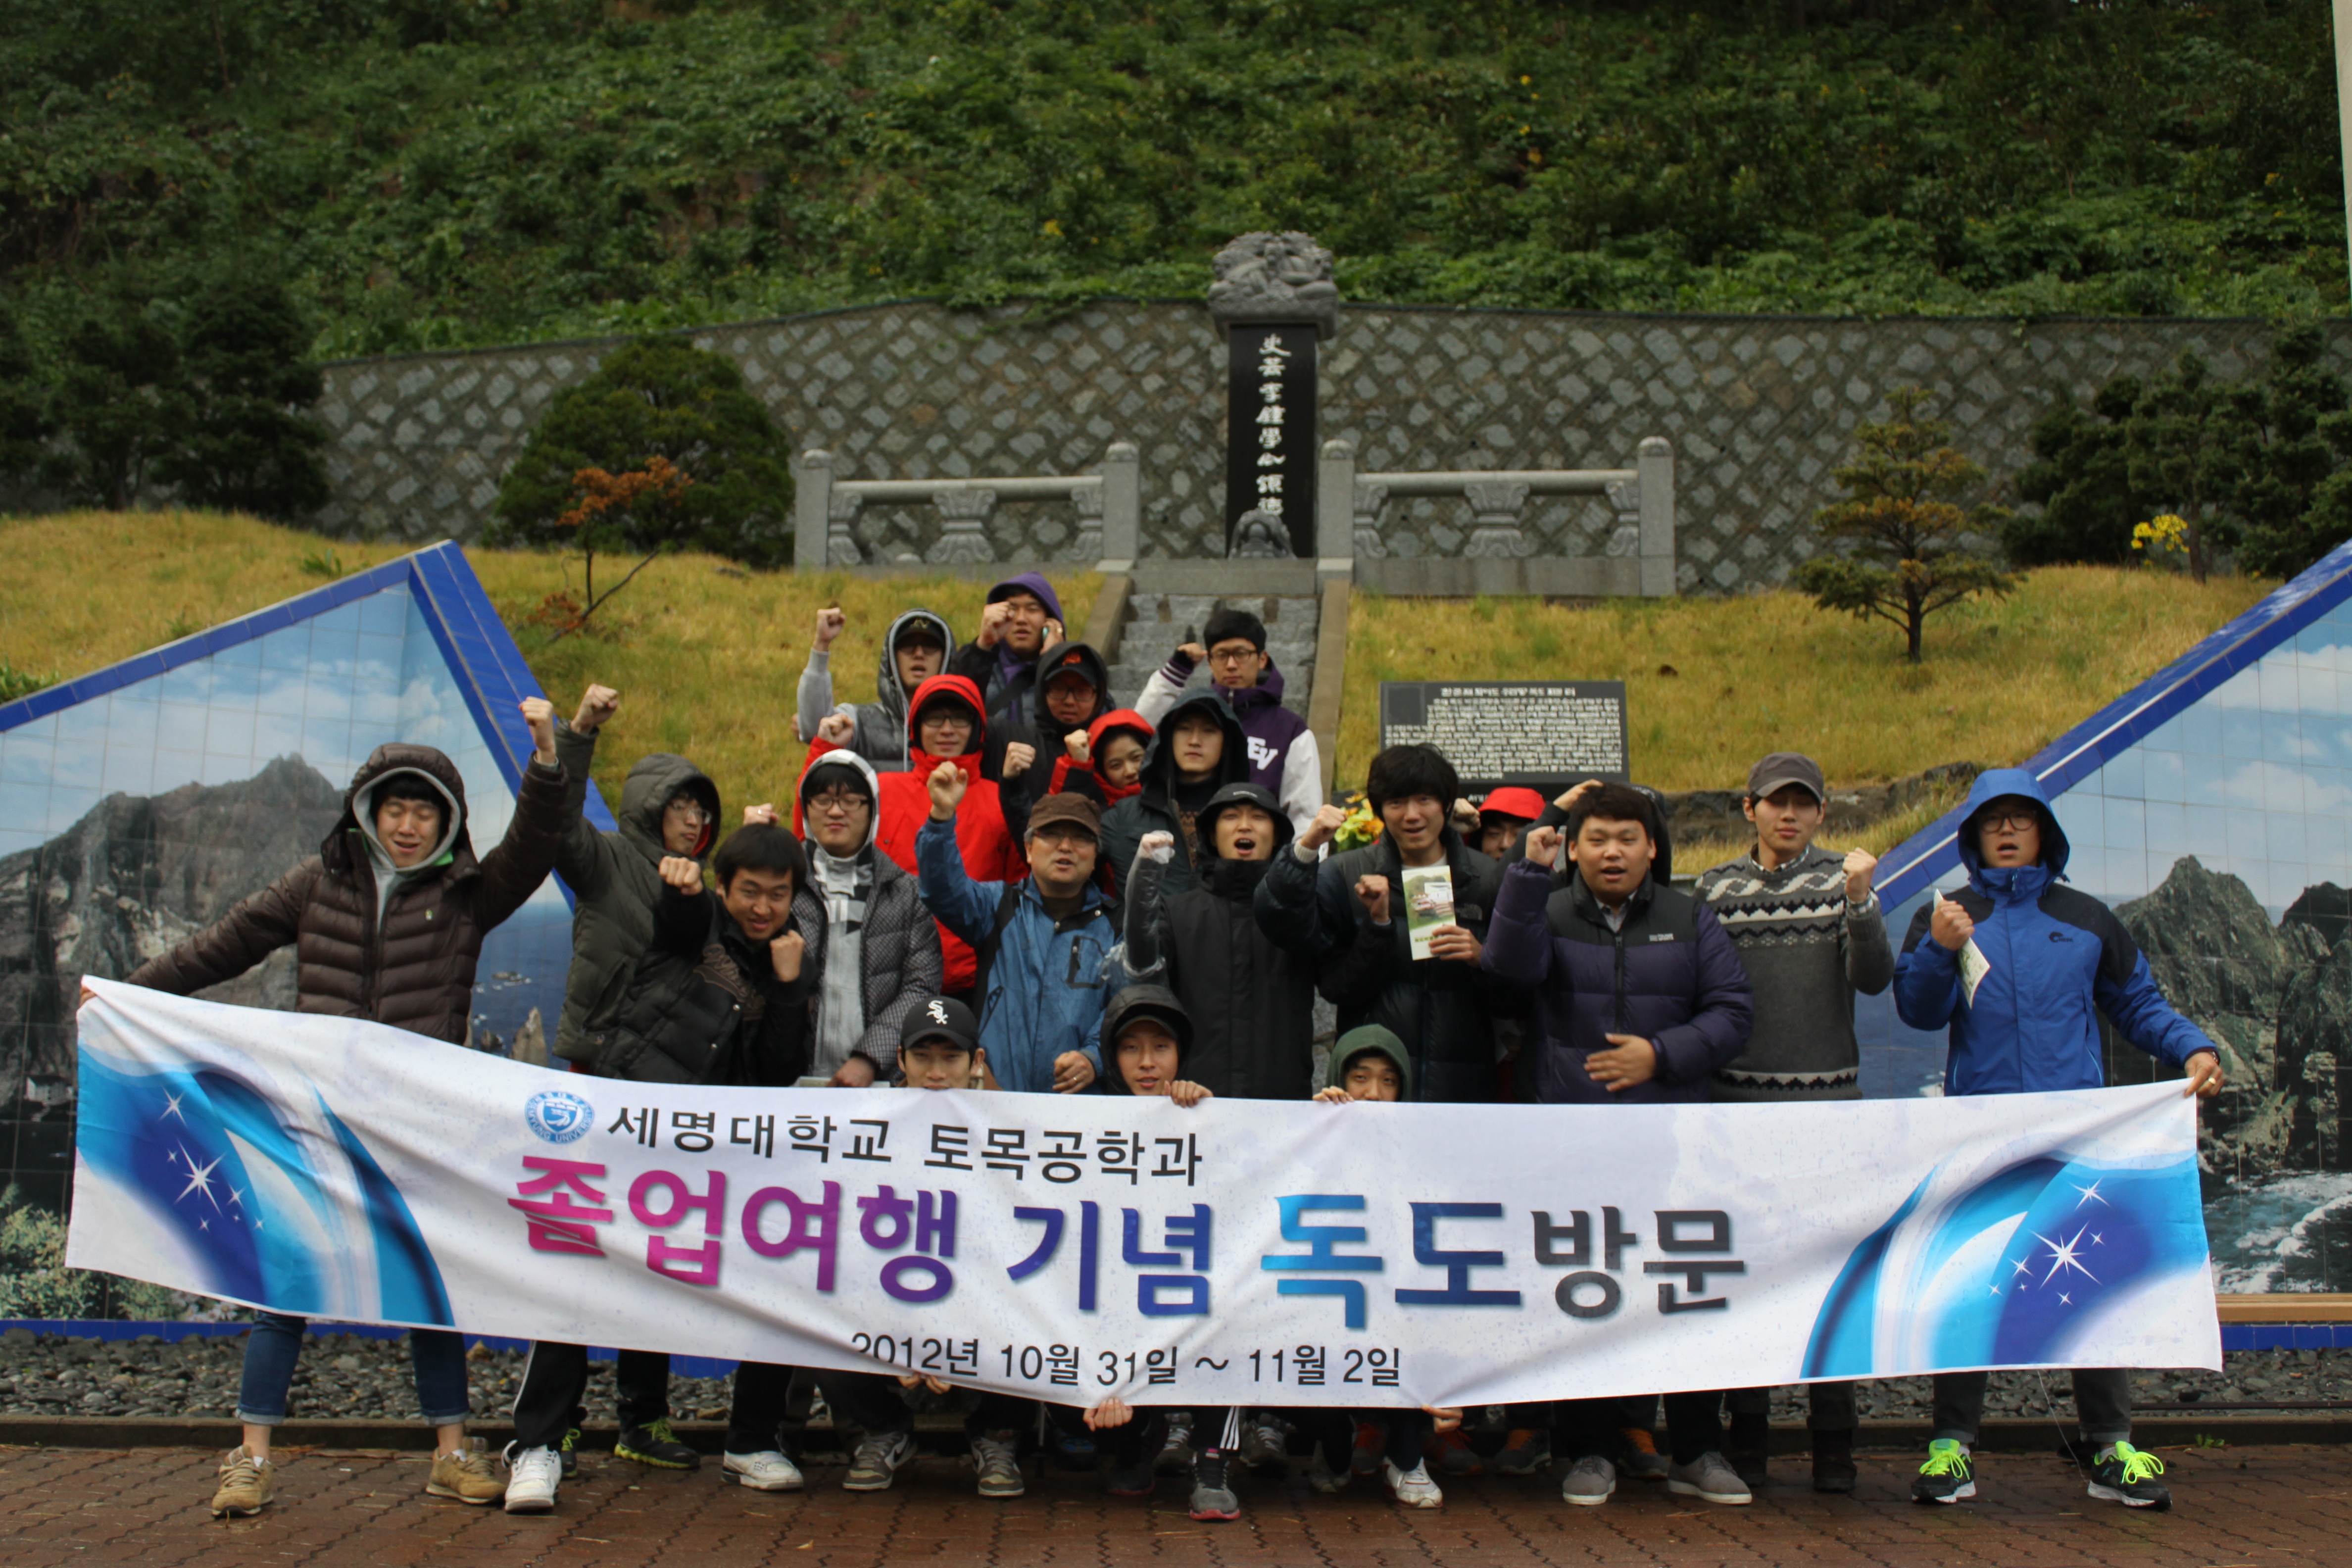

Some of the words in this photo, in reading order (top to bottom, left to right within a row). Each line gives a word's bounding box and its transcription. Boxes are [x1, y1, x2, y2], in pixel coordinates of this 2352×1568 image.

[1247, 735, 1278, 771] EV
[607, 1107, 892, 1164] 세명대학교
[924, 1123, 1203, 1186] 토목공학과
[507, 1155, 958, 1303] 졸업여행
[1006, 1200, 1211, 1316] 기념
[1260, 1194, 1744, 1330] 독도방문
[851, 1332, 979, 1376] 2012년
[1000, 1343, 1079, 1386] 10월
[1096, 1346, 1177, 1386] 31일
[1249, 1344, 1326, 1385] 11월
[1343, 1347, 1400, 1387] 2일
